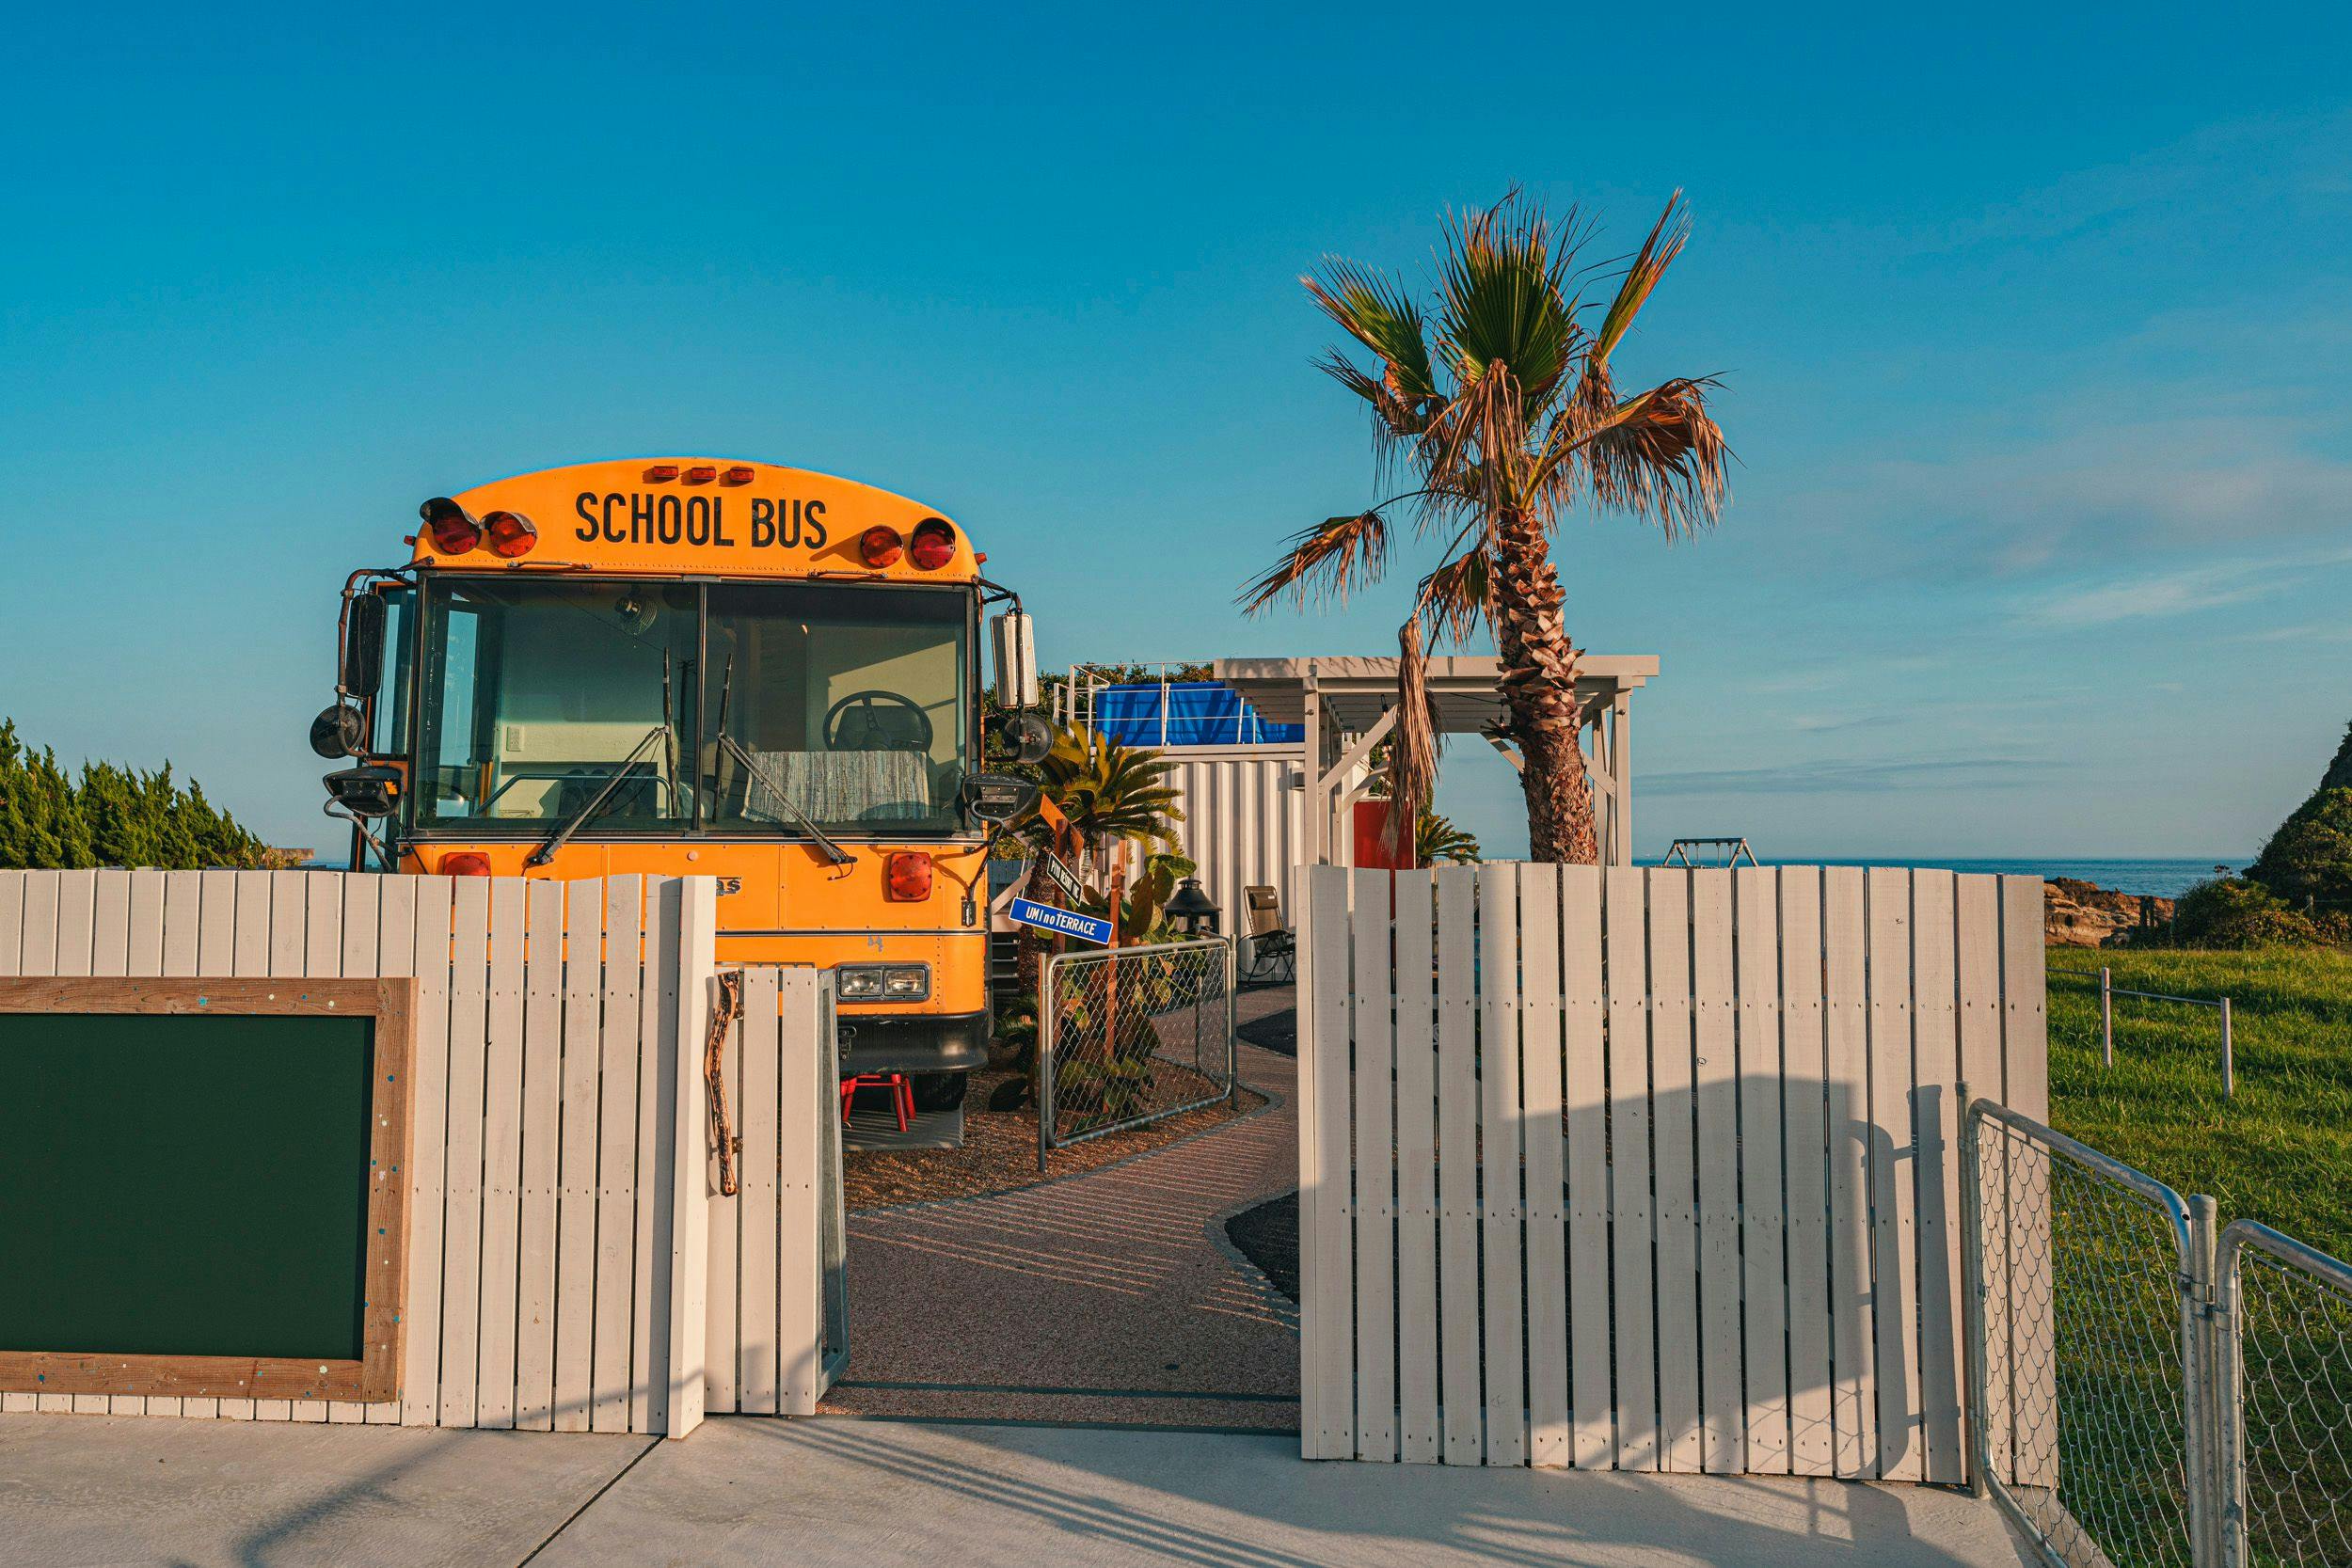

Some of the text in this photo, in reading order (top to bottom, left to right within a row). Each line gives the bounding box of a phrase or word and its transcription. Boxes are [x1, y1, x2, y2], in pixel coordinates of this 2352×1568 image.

[576, 492, 827, 549] SCHOOL BUS
[1056, 913, 1097, 936] TERRACE
